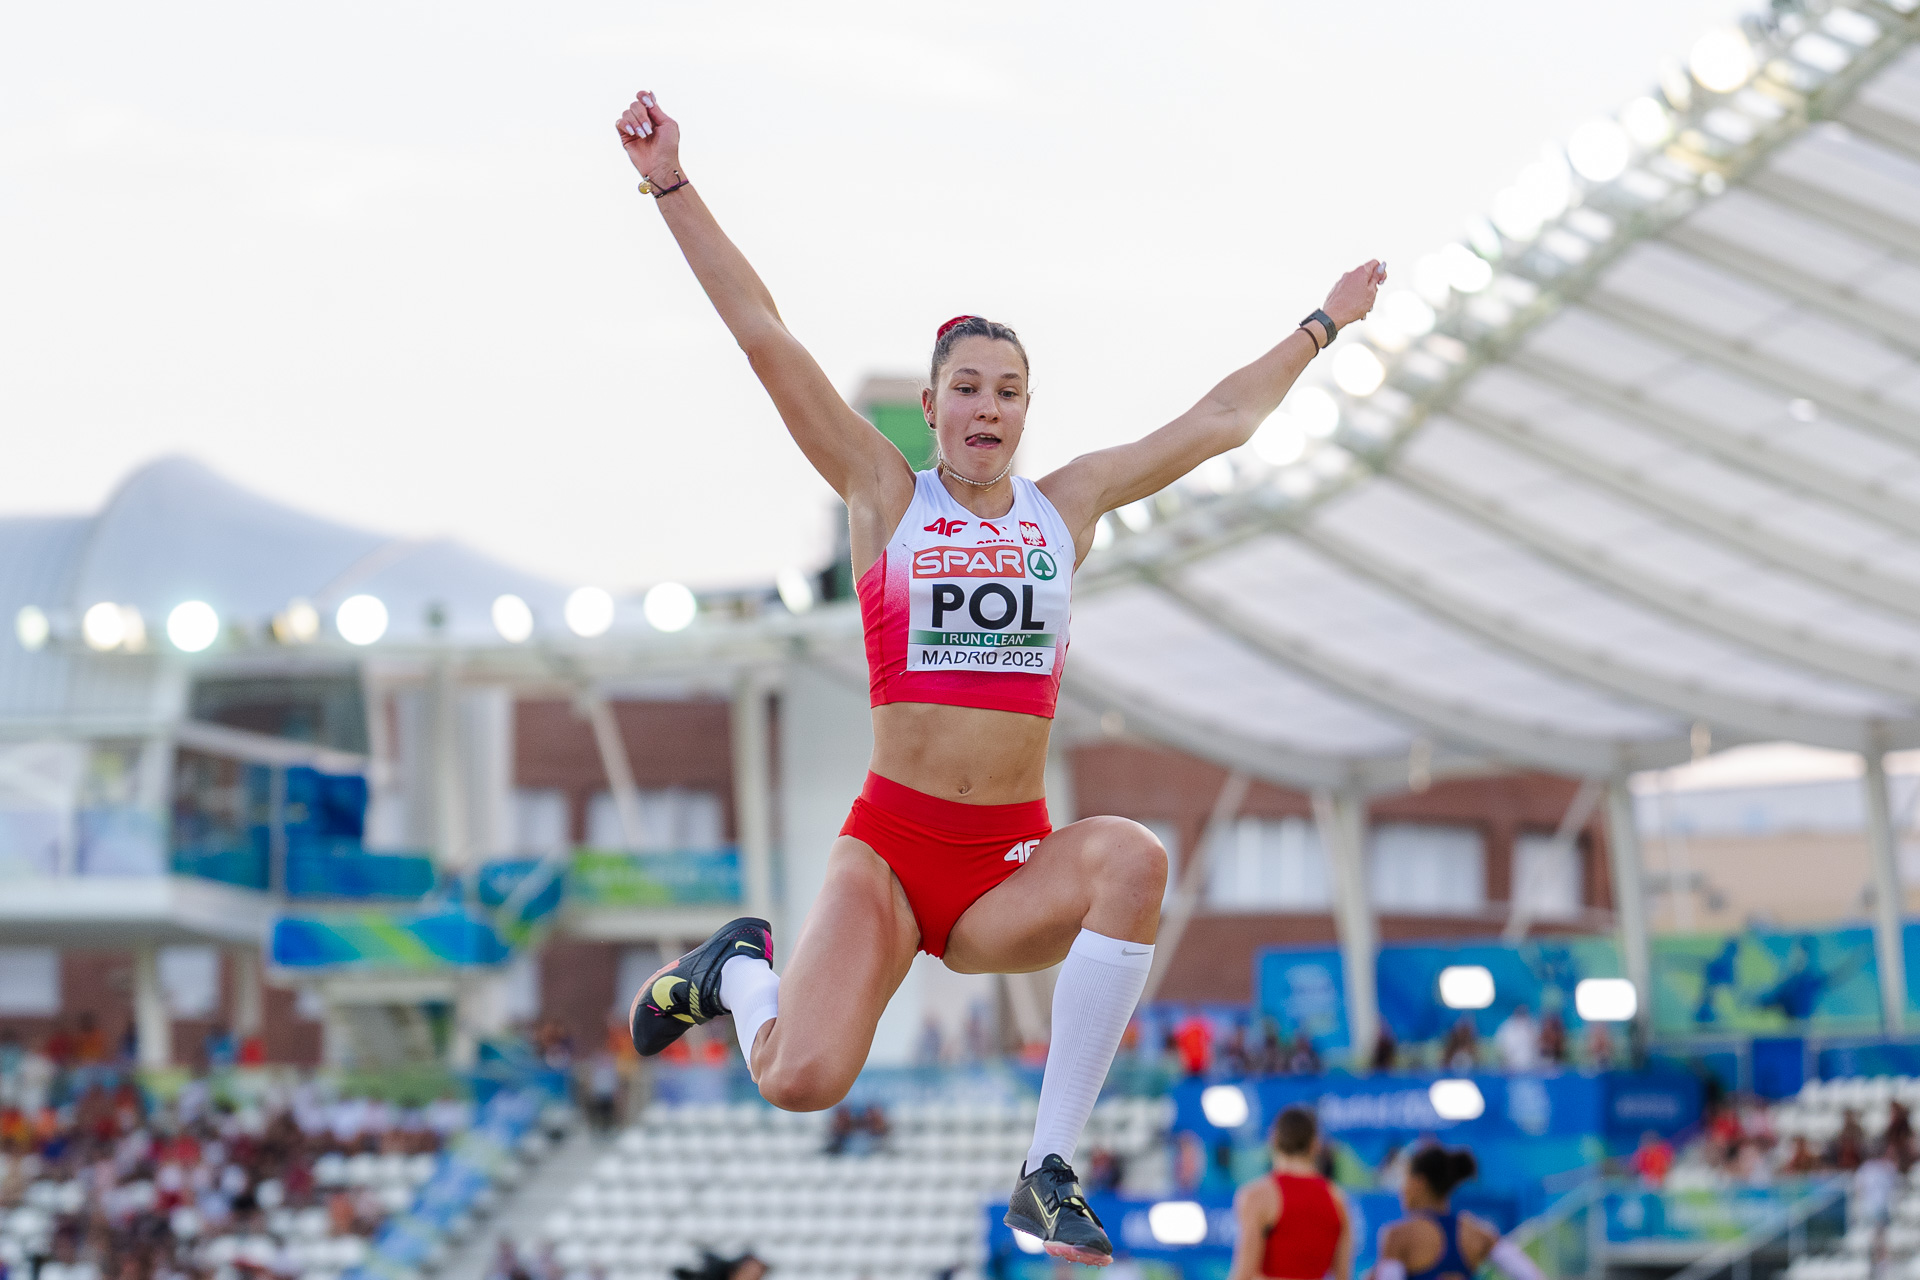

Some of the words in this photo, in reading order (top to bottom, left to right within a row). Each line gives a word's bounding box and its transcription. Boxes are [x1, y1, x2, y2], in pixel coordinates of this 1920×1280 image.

[915, 549, 1022, 575] SPAR
[931, 583, 1045, 630] POL
[942, 634, 946, 643] I
[949, 634, 980, 645] RUN
[921, 650, 997, 666] MADRID
[1002, 651, 1043, 667] 2025
